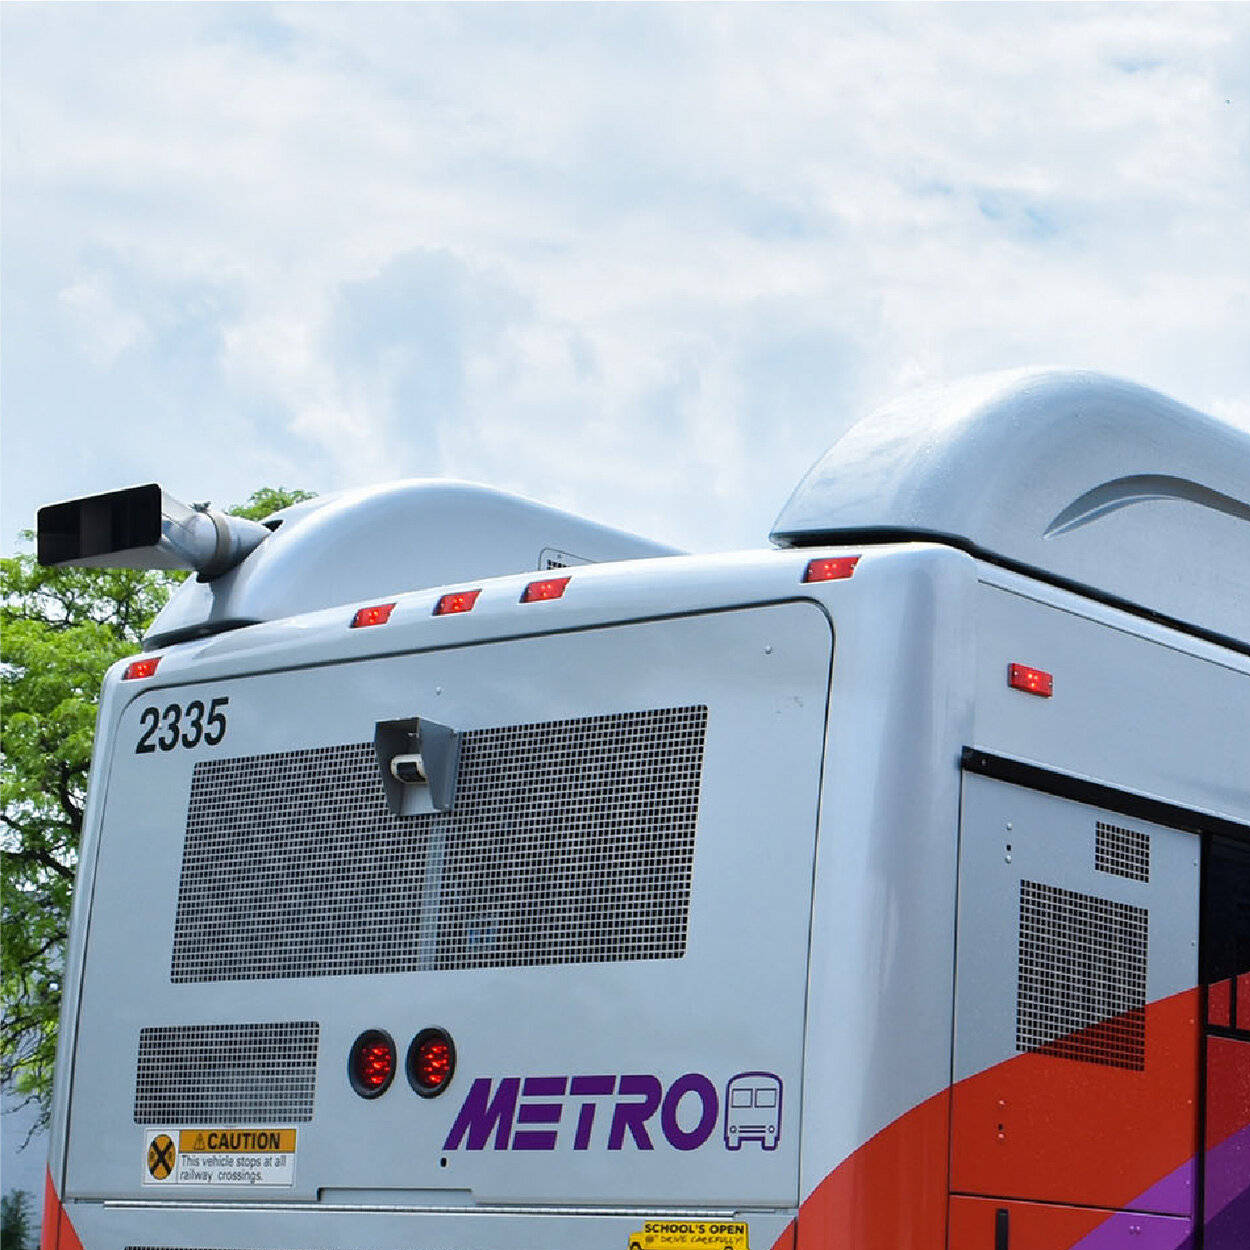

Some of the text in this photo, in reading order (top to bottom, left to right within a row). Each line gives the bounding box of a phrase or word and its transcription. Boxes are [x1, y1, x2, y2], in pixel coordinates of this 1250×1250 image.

[136, 696, 229, 754] 2335
[442, 1073, 719, 1151] METRO
[207, 1132, 281, 1150] CAUTION
[181, 1154, 287, 1170] This vehicle stops at all
[180, 1169, 213, 1183] railway
[644, 1223, 745, 1235] SCHOOL'S OPEN
